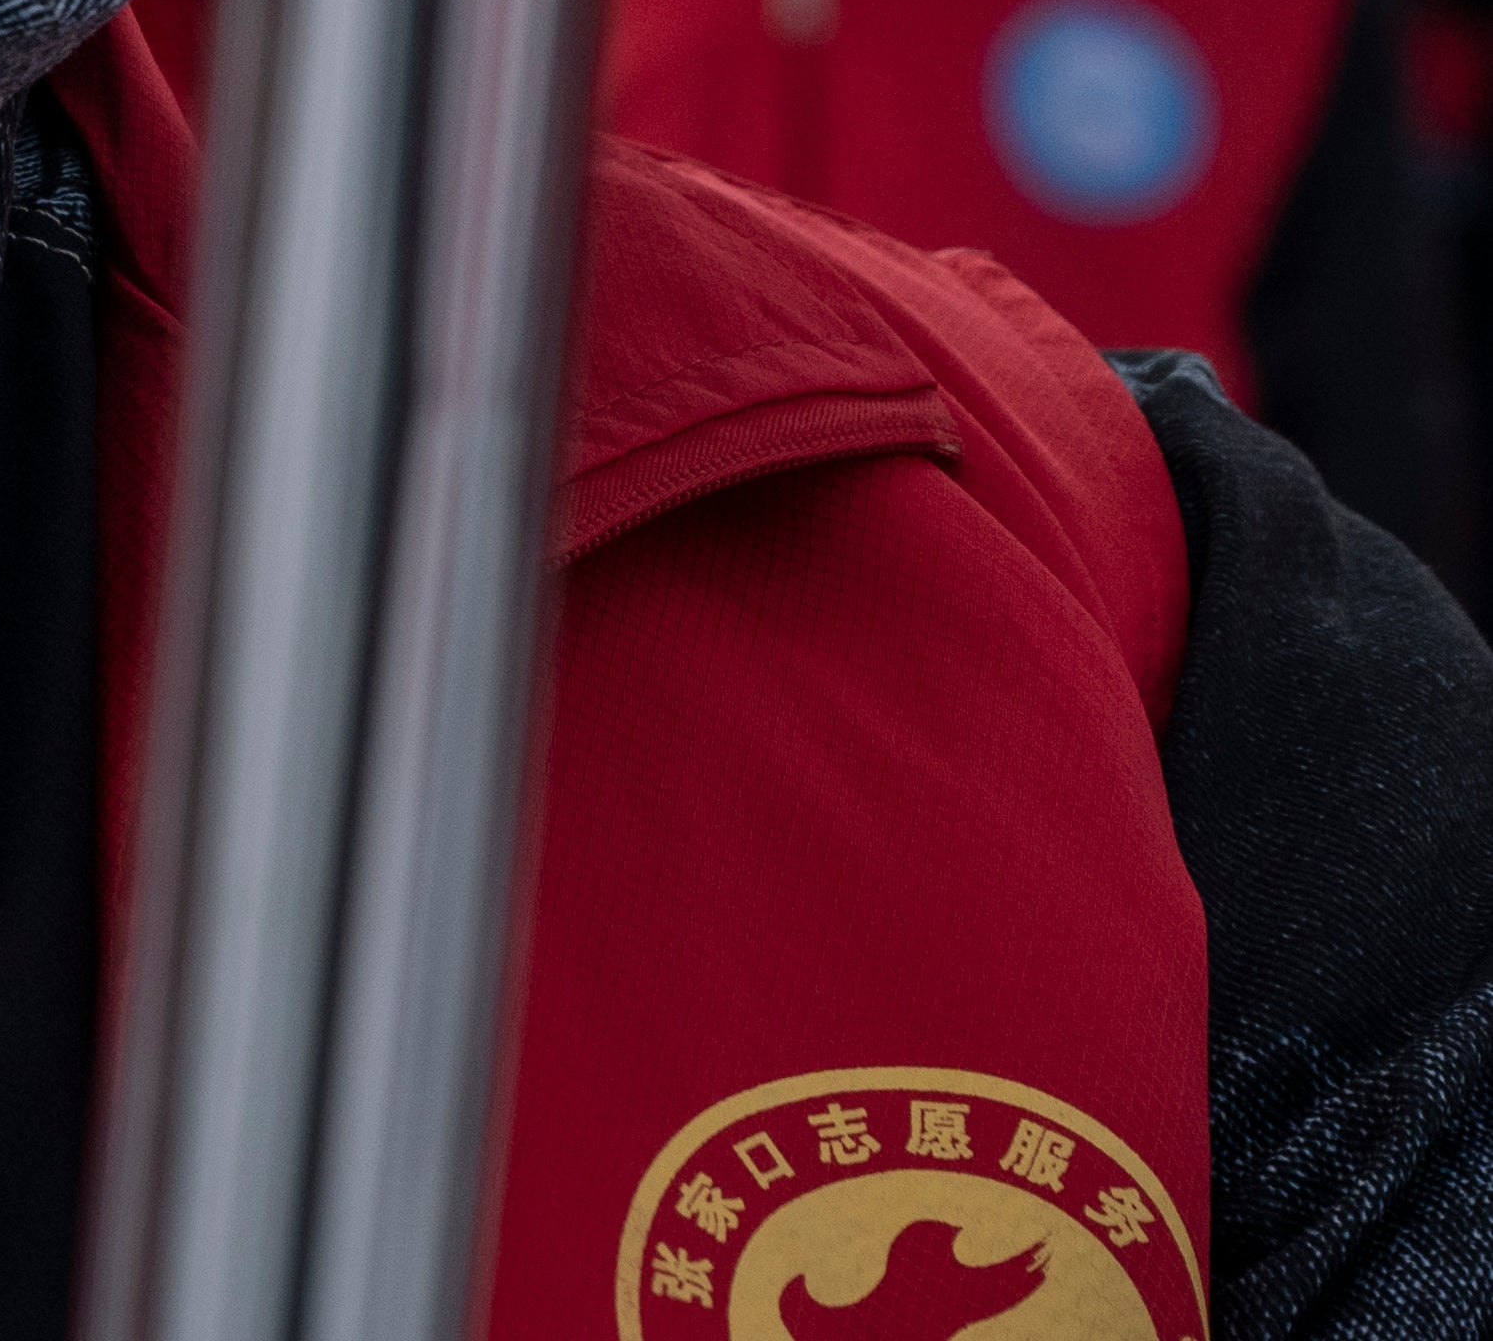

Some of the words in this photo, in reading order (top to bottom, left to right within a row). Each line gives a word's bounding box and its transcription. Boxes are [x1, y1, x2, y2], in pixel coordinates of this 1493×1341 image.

[650, 1099, 1160, 1310] 张家口志愿服务
